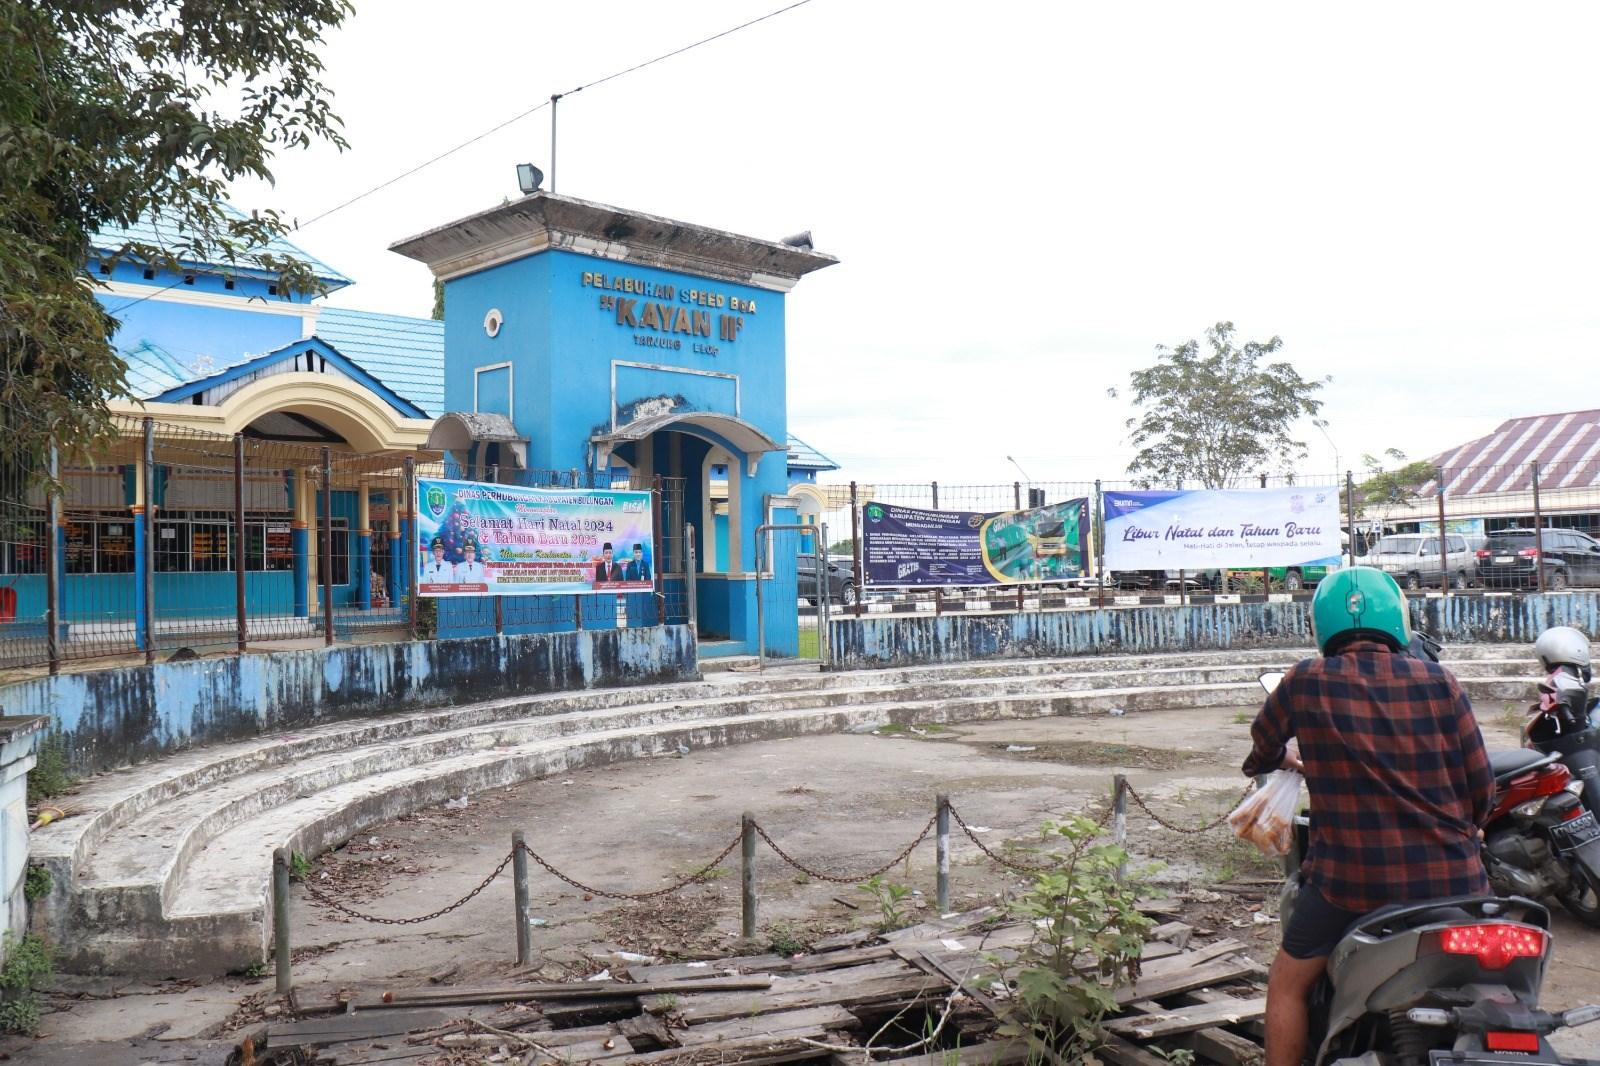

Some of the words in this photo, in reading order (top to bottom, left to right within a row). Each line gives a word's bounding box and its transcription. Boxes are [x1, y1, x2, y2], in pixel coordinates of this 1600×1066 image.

[581, 271, 675, 300] PELABUHAN
[680, 288, 725, 308] SPEED
[458, 489, 480, 500] DINAS
[578, 496, 614, 506] BULUNGAN
[460, 514, 513, 530] Selamat
[517, 516, 544, 531] Hari
[548, 518, 581, 531] Natal
[584, 520, 614, 532] 2024
[1122, 525, 1160, 541] Libur
[1165, 525, 1204, 541] Natal
[1208, 526, 1234, 537] dan
[1239, 523, 1280, 538] Tahun
[1285, 521, 1322, 538] Baru
[493, 531, 535, 545] Tahun
[539, 532, 569, 546] Baru
[570, 534, 597, 546] 2025
